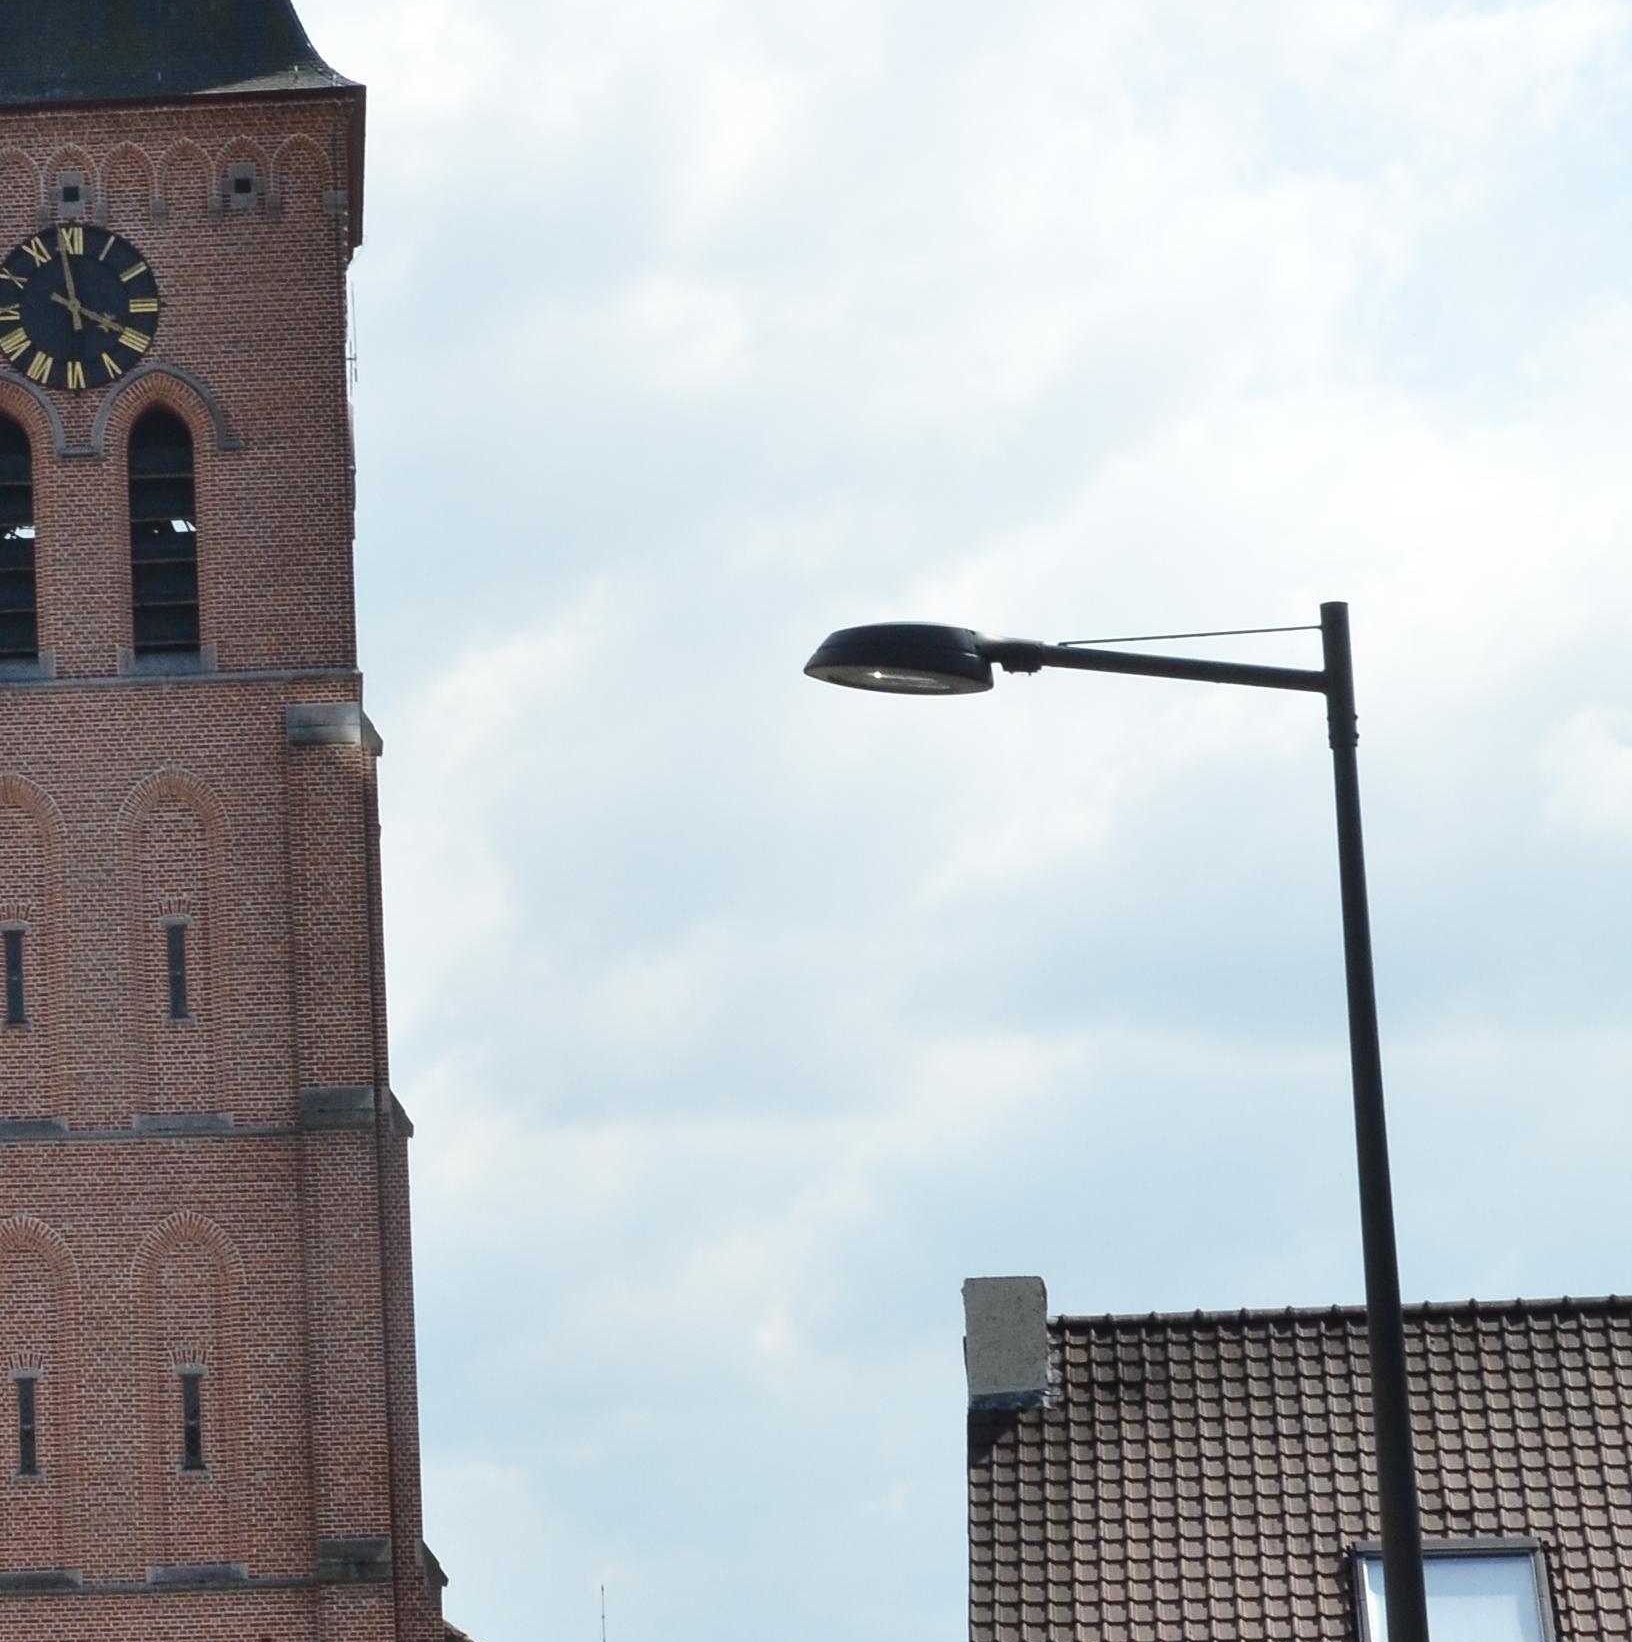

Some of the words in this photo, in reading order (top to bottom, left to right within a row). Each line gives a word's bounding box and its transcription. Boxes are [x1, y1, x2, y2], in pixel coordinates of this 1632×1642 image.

[21, 236, 53, 268] XI
[60, 227, 84, 255] XII
[99, 235, 116, 262] I
[120, 261, 148, 283] II
[129, 298, 158, 313] III
